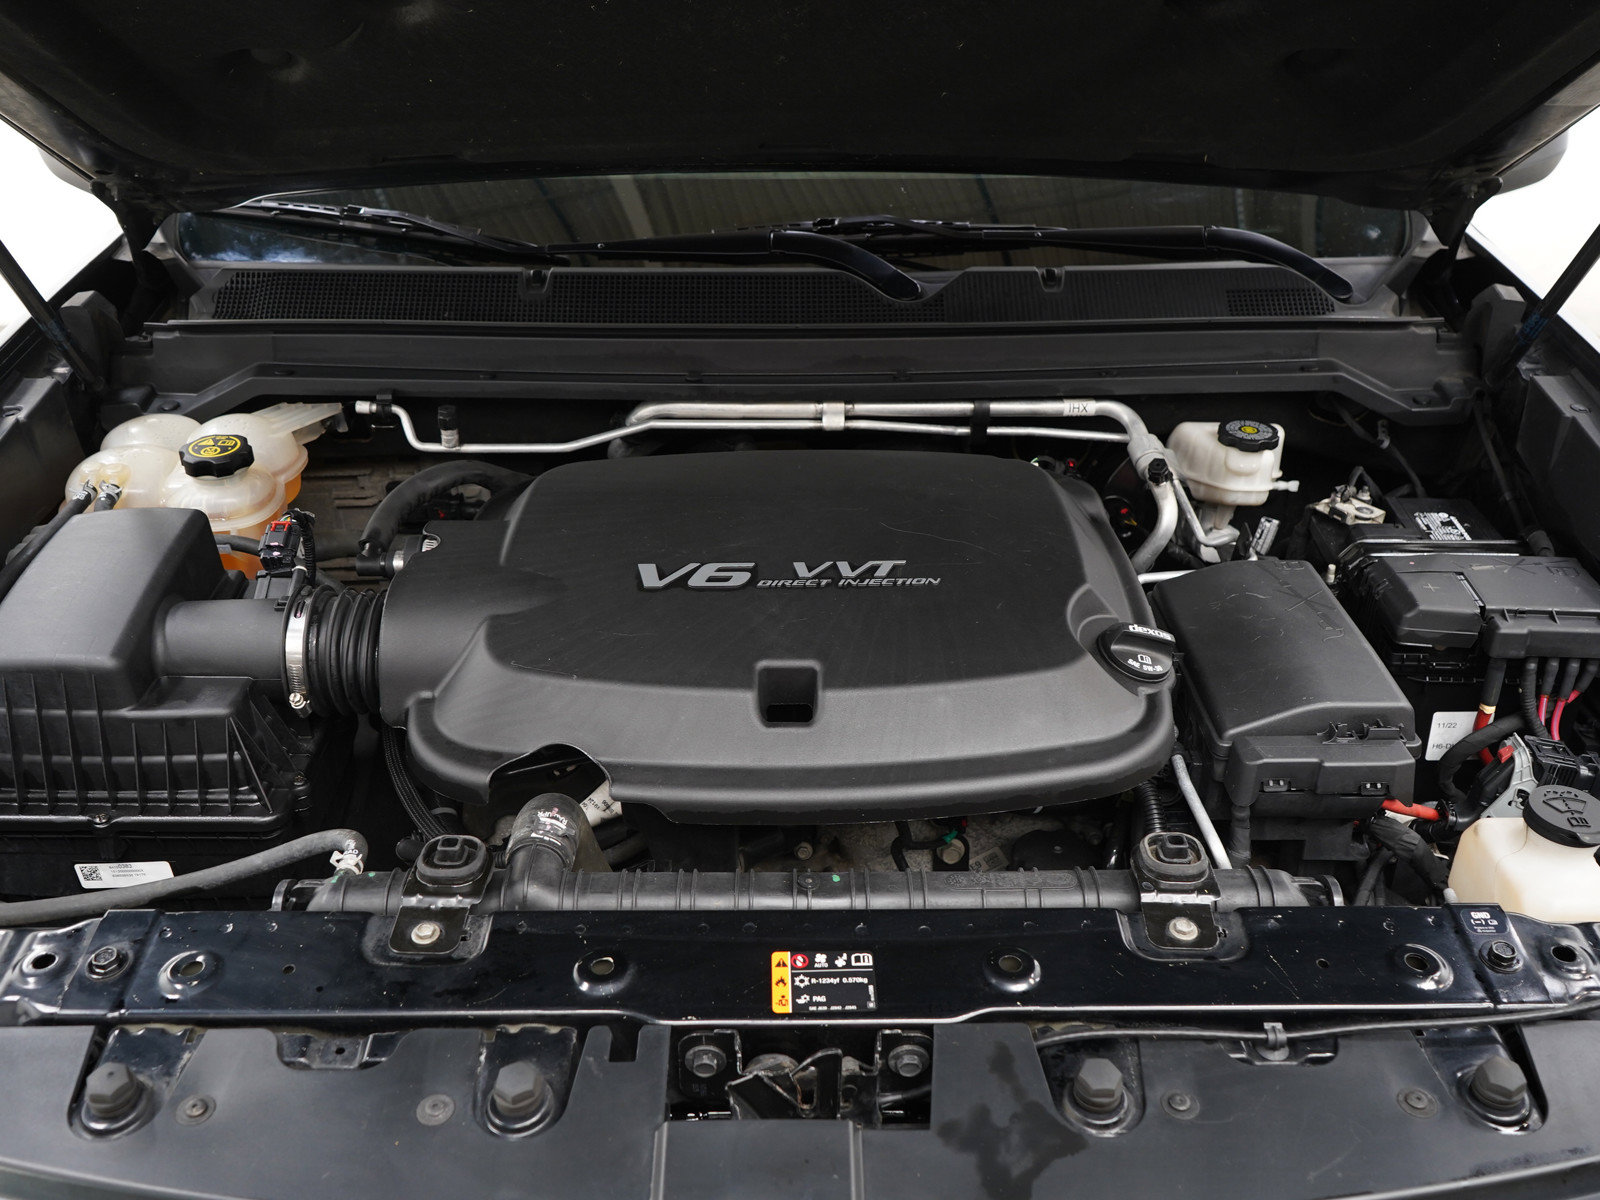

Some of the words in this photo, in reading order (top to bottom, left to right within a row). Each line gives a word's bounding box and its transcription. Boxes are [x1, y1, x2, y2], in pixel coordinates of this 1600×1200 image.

[637, 562, 756, 588] V6
[792, 559, 907, 578] VVT
[756, 578, 832, 588] DIRECT
[838, 577, 941, 588] INJECTION
[1128, 624, 1172, 641] dexos
[1127, 658, 1141, 669] SAE
[811, 977, 840, 985] R-1234yf
[812, 995, 827, 1003] PAG
